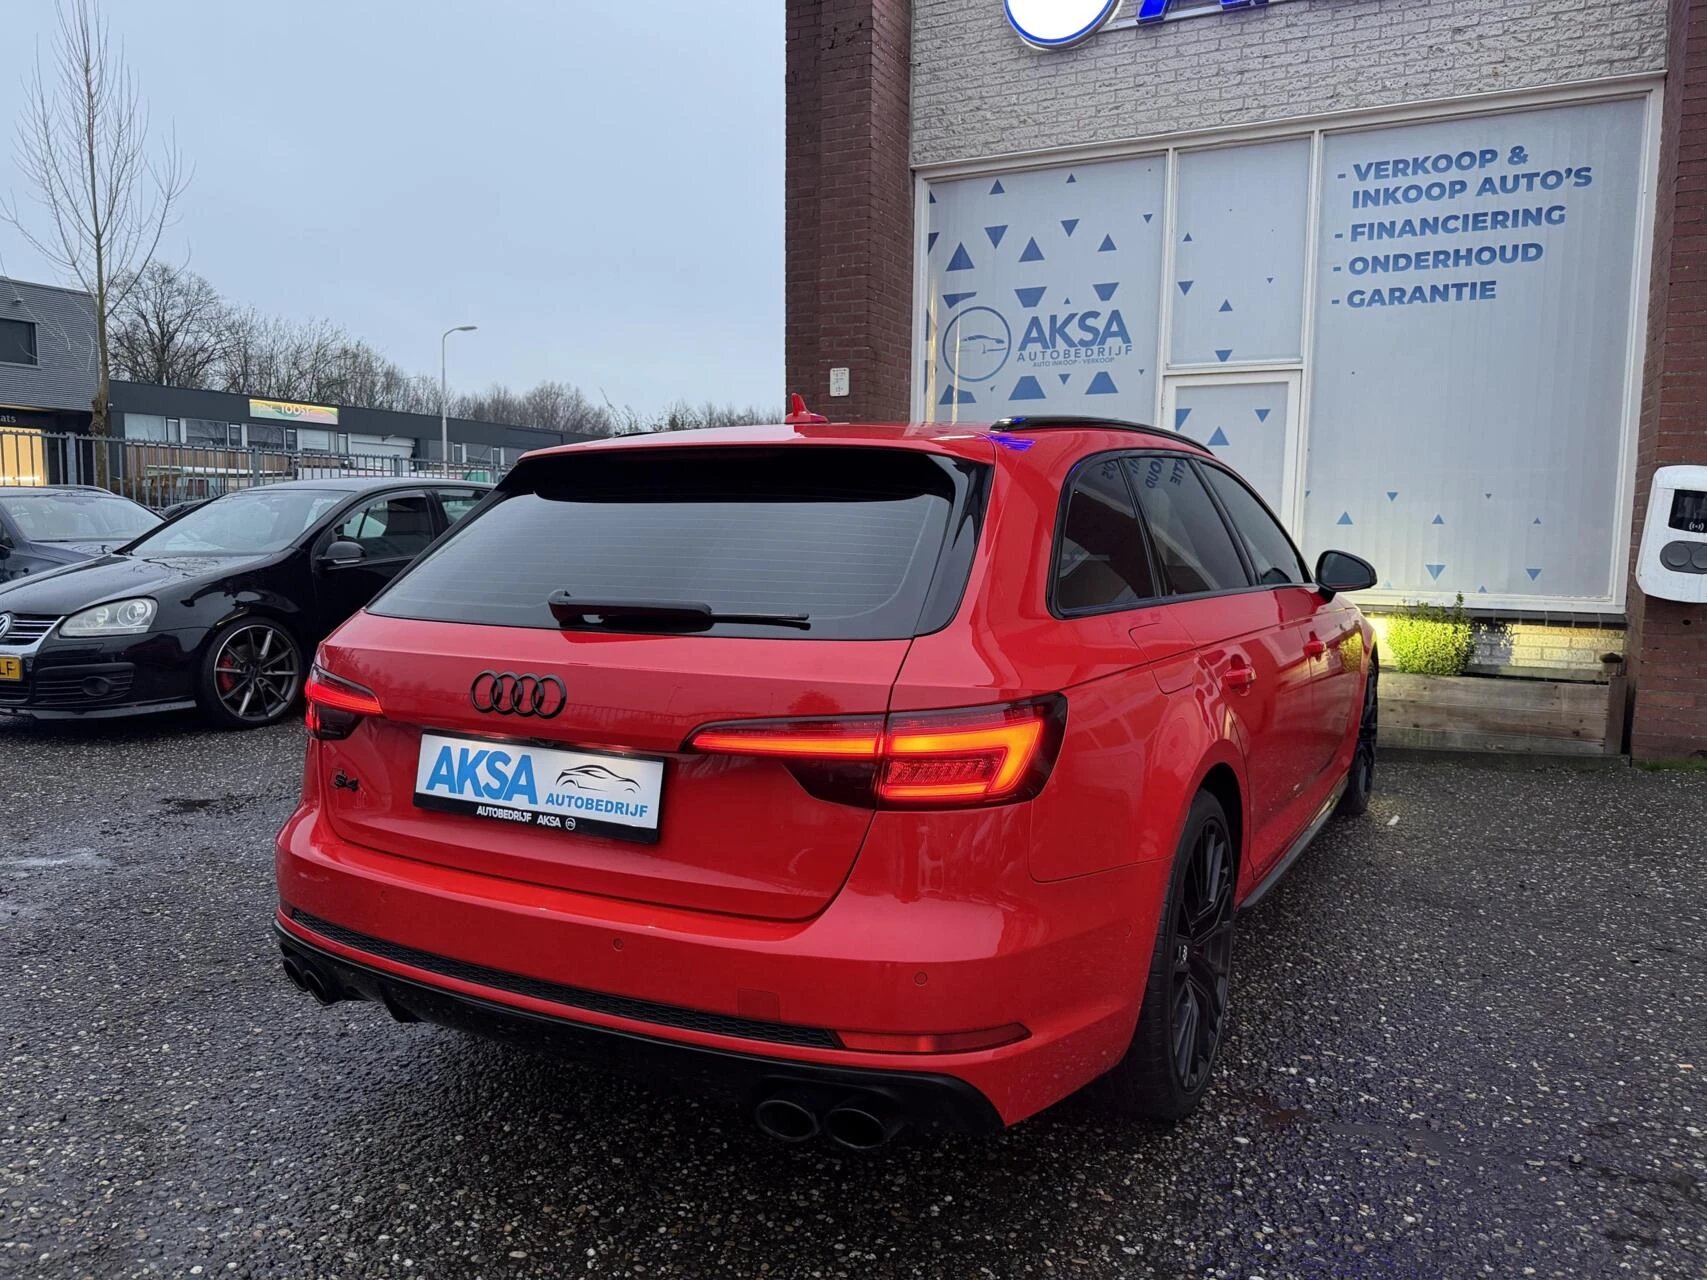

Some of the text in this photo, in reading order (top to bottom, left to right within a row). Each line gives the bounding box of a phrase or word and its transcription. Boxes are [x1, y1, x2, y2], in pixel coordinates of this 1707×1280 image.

[1353, 149, 1498, 181] VERKOOP
[1507, 145, 1528, 166] &
[1352, 166, 1592, 209] INKOOP AUTO'S
[1350, 205, 1566, 242] FINANCIERING
[1348, 242, 1544, 275] ONDERHOUD
[1346, 280, 1497, 308] GARANTIE
[1018, 309, 1132, 351] AKSA
[1016, 344, 1133, 362] AUTOBEDRIJF
[425, 745, 538, 805] AKSA
[476, 805, 561, 827] AUTOBEDRIJF AKSA
[545, 792, 648, 818] AUTOBEDRIJF
